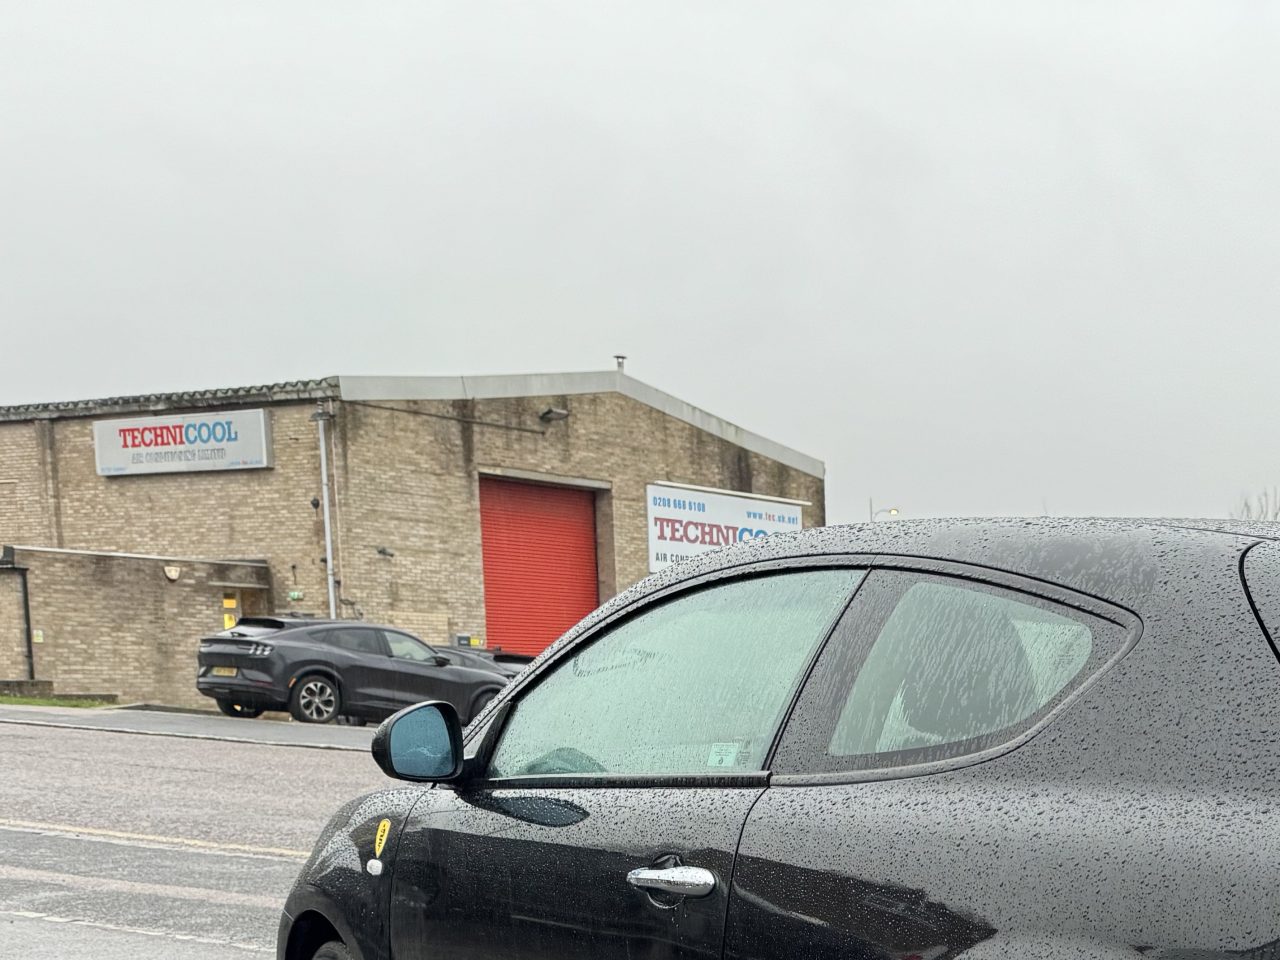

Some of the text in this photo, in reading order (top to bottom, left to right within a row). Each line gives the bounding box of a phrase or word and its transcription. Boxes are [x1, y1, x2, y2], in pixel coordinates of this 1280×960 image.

[119, 421, 238, 448] TECHNICOOL
[653, 496, 671, 508] 0208
[655, 552, 668, 562] AIR
